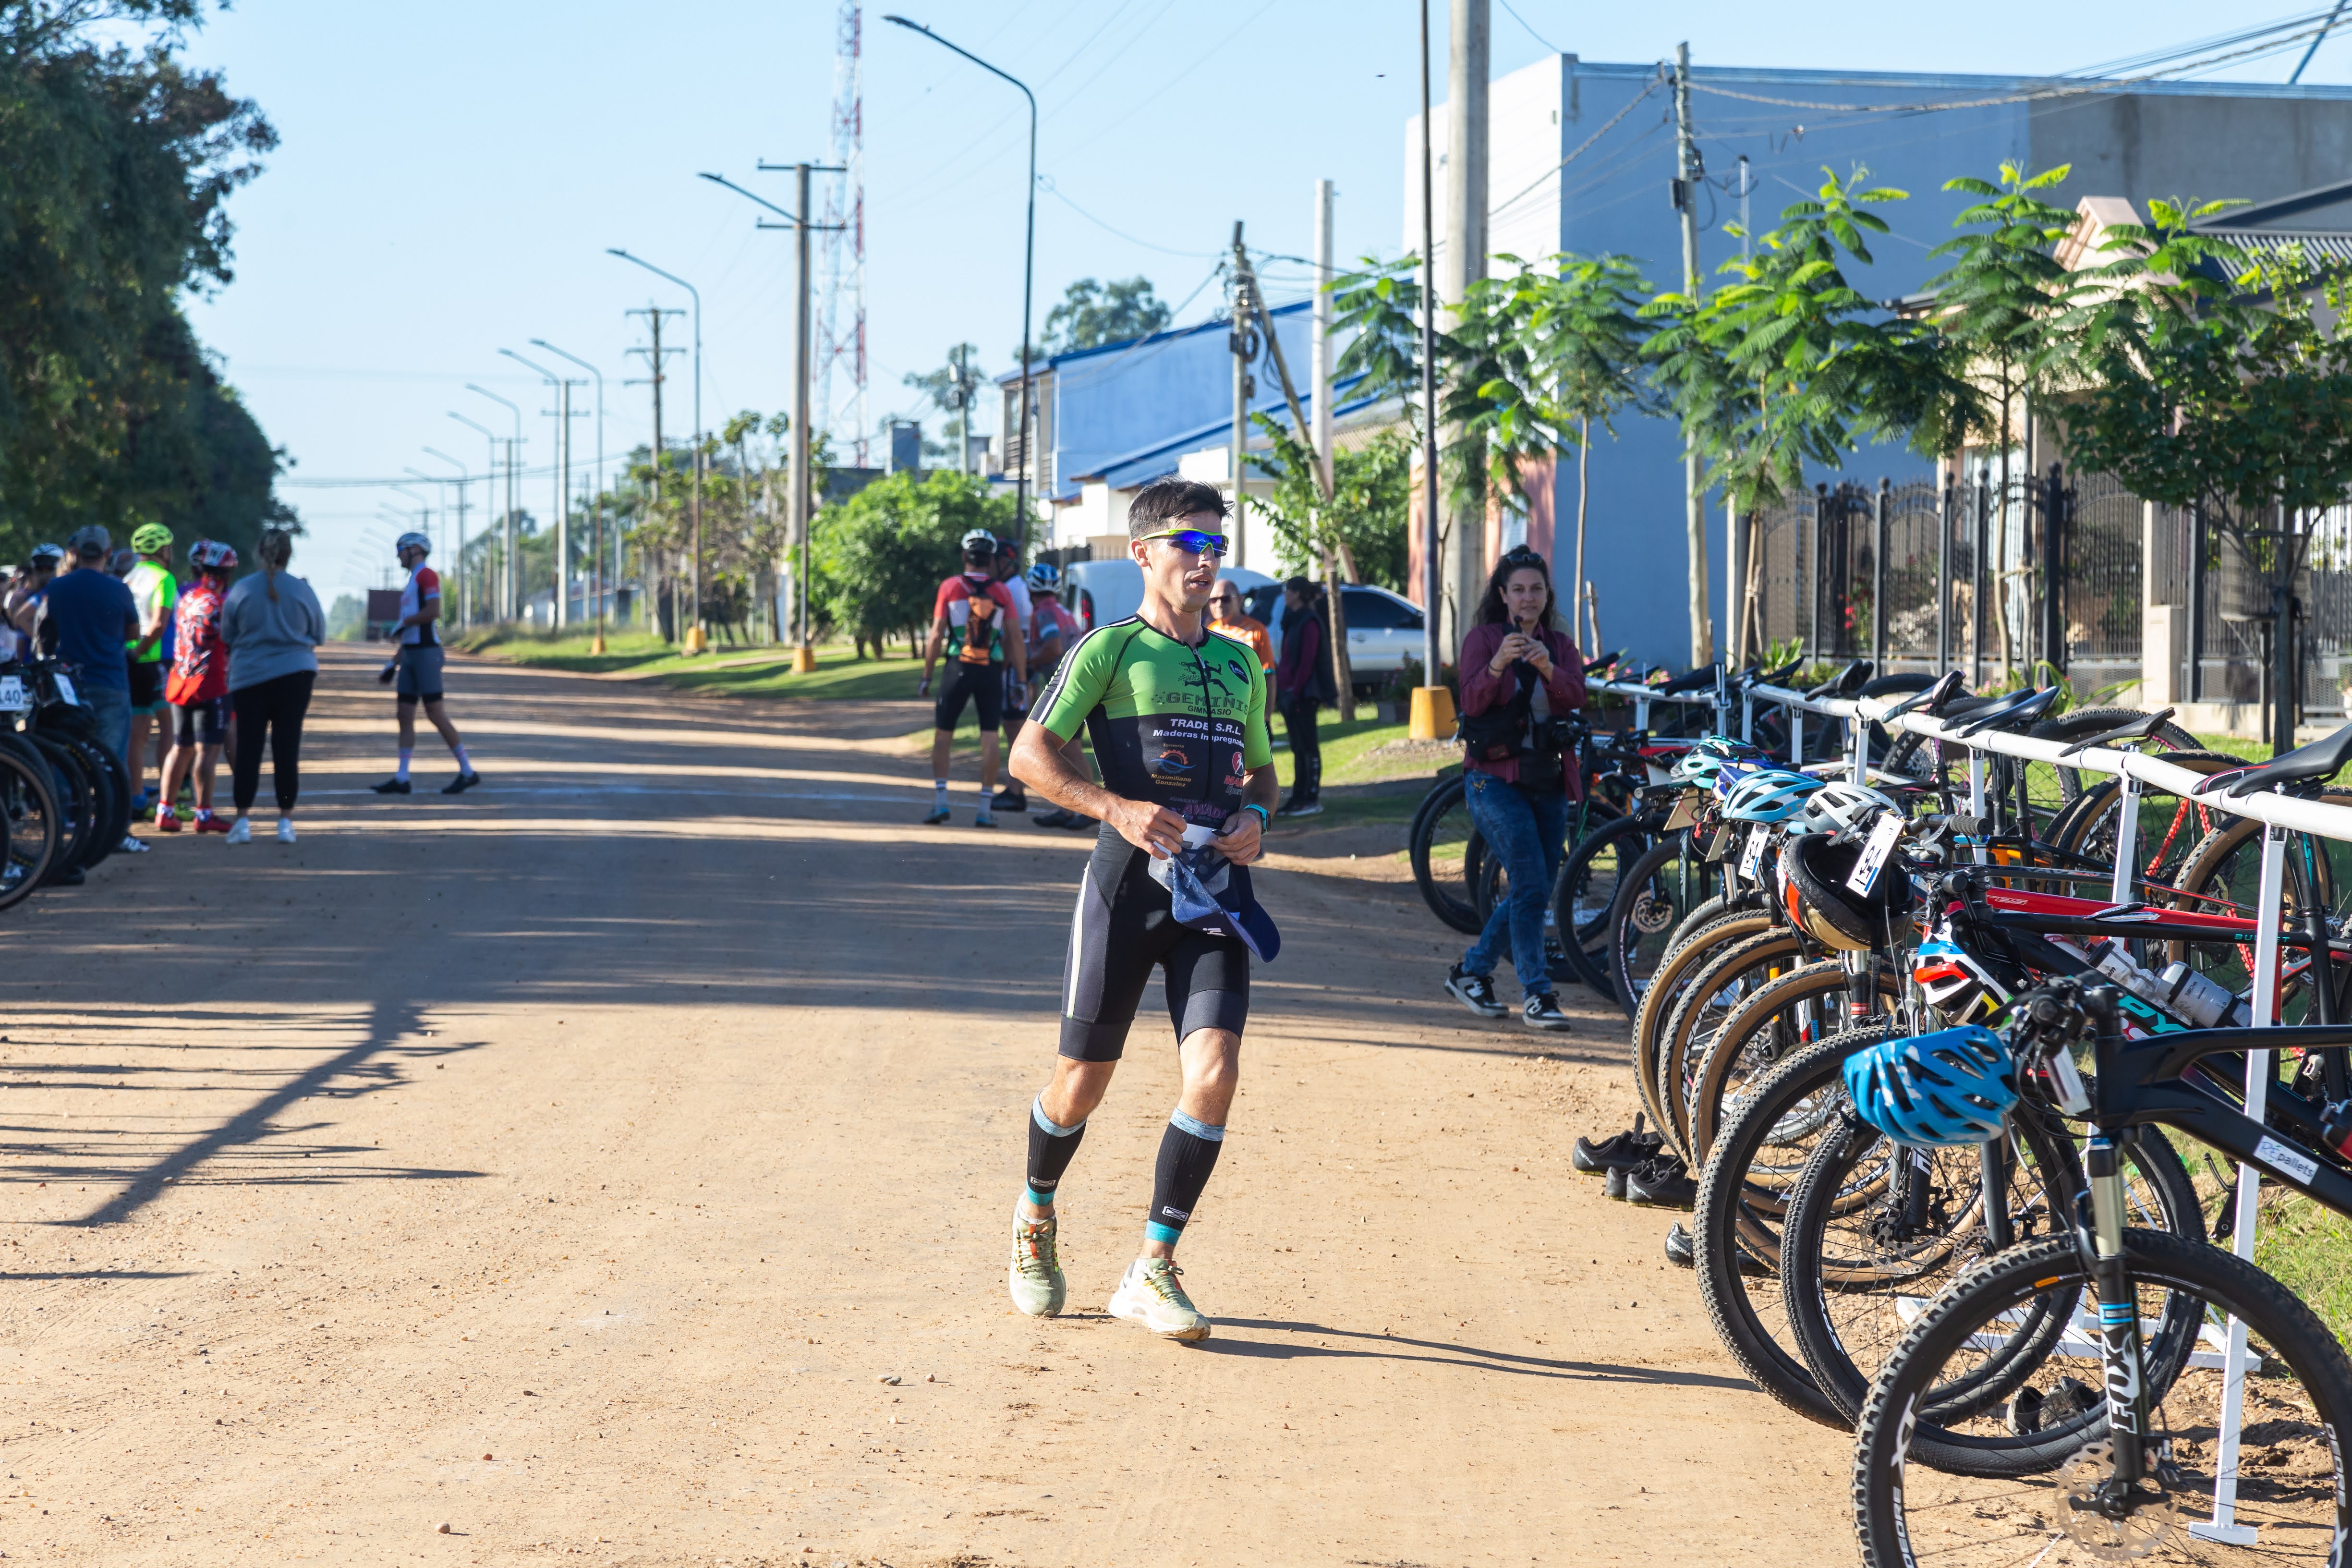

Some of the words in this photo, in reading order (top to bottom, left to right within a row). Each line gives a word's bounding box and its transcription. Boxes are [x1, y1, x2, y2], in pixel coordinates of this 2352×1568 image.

[1166, 692, 1249, 716] GEMINIS
[1188, 705, 1232, 716] GIMNASIO
[1153, 729, 1198, 739] Maderas
[1170, 718, 1212, 731] TRADE
[1215, 723, 1241, 736] S.R.L.
[1151, 774, 1191, 782] Maximiliano
[2276, 1153, 2314, 1178] pallets
[2101, 1330, 2140, 1435] FOX
[2324, 1422, 2346, 1508] DEORE
[1891, 1486, 1917, 1568] DEORE
